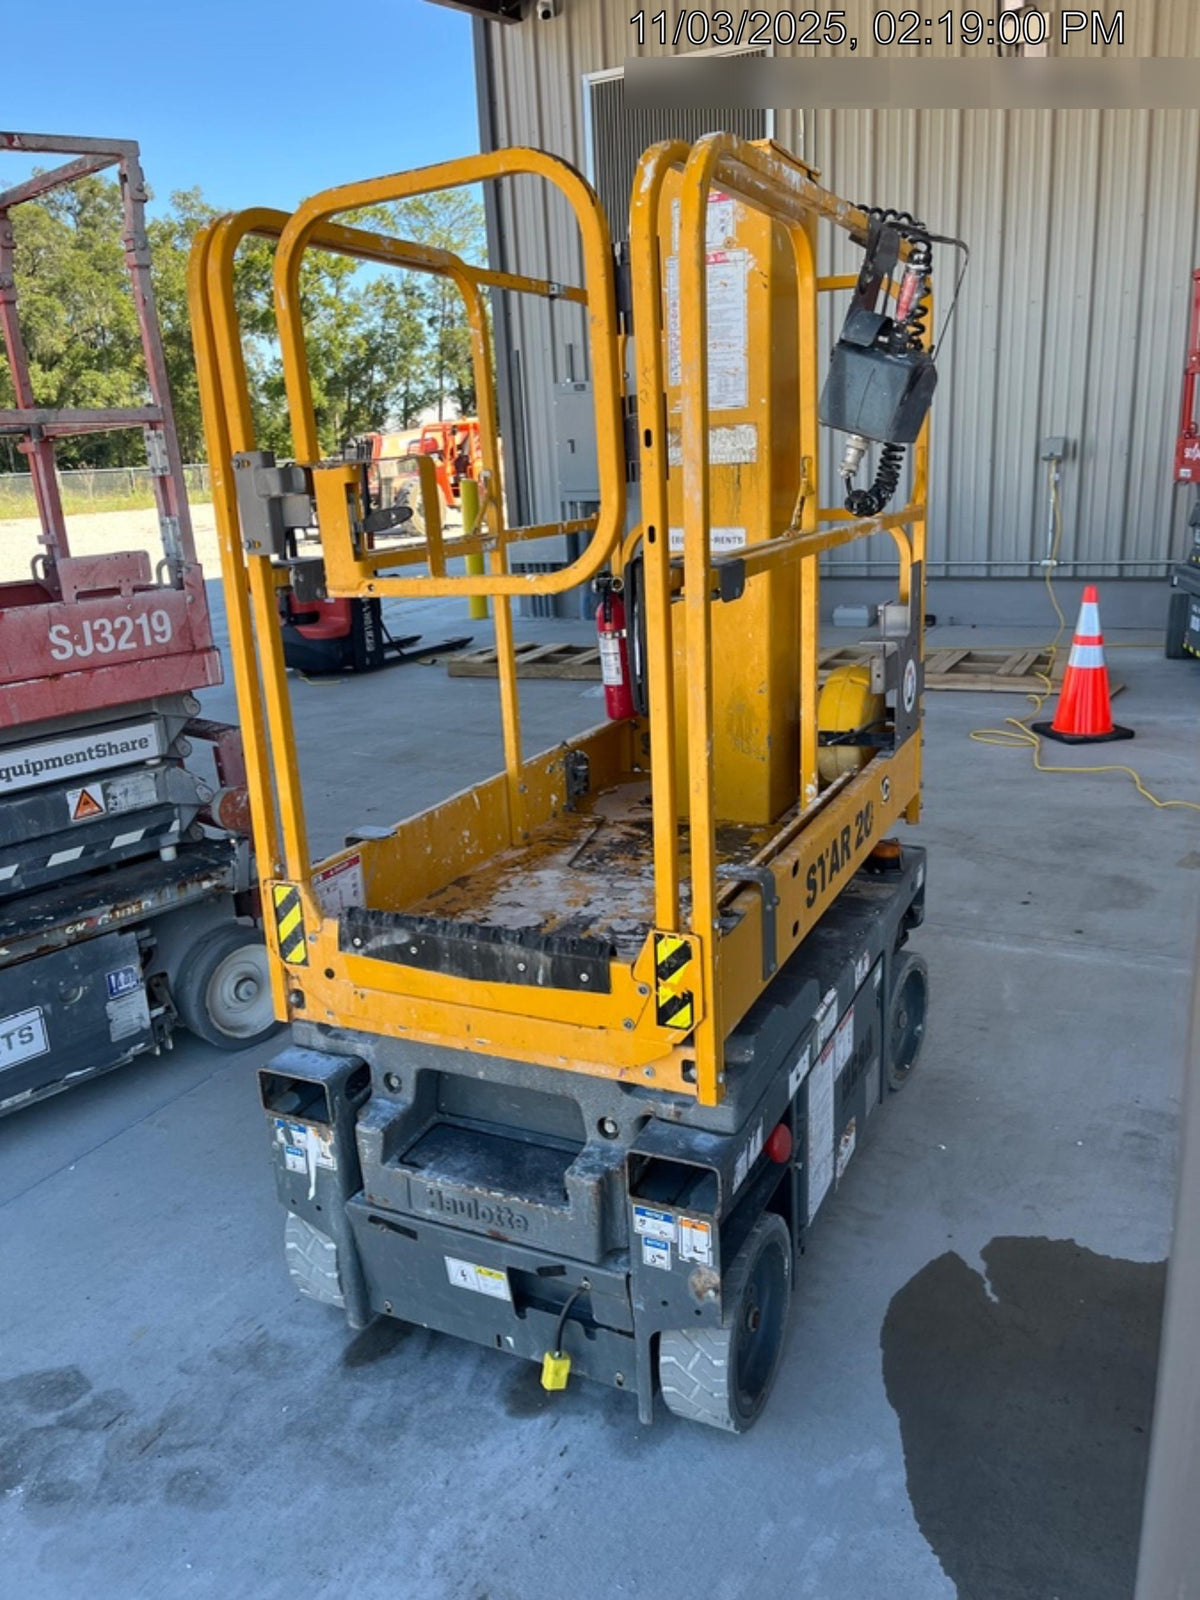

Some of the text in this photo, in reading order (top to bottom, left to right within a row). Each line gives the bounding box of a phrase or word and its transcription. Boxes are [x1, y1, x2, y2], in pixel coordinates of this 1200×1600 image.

[50, 609, 172, 660] SJ3219
[806, 824, 851, 909] STAR
[426, 1185, 529, 1233] Haulotte
